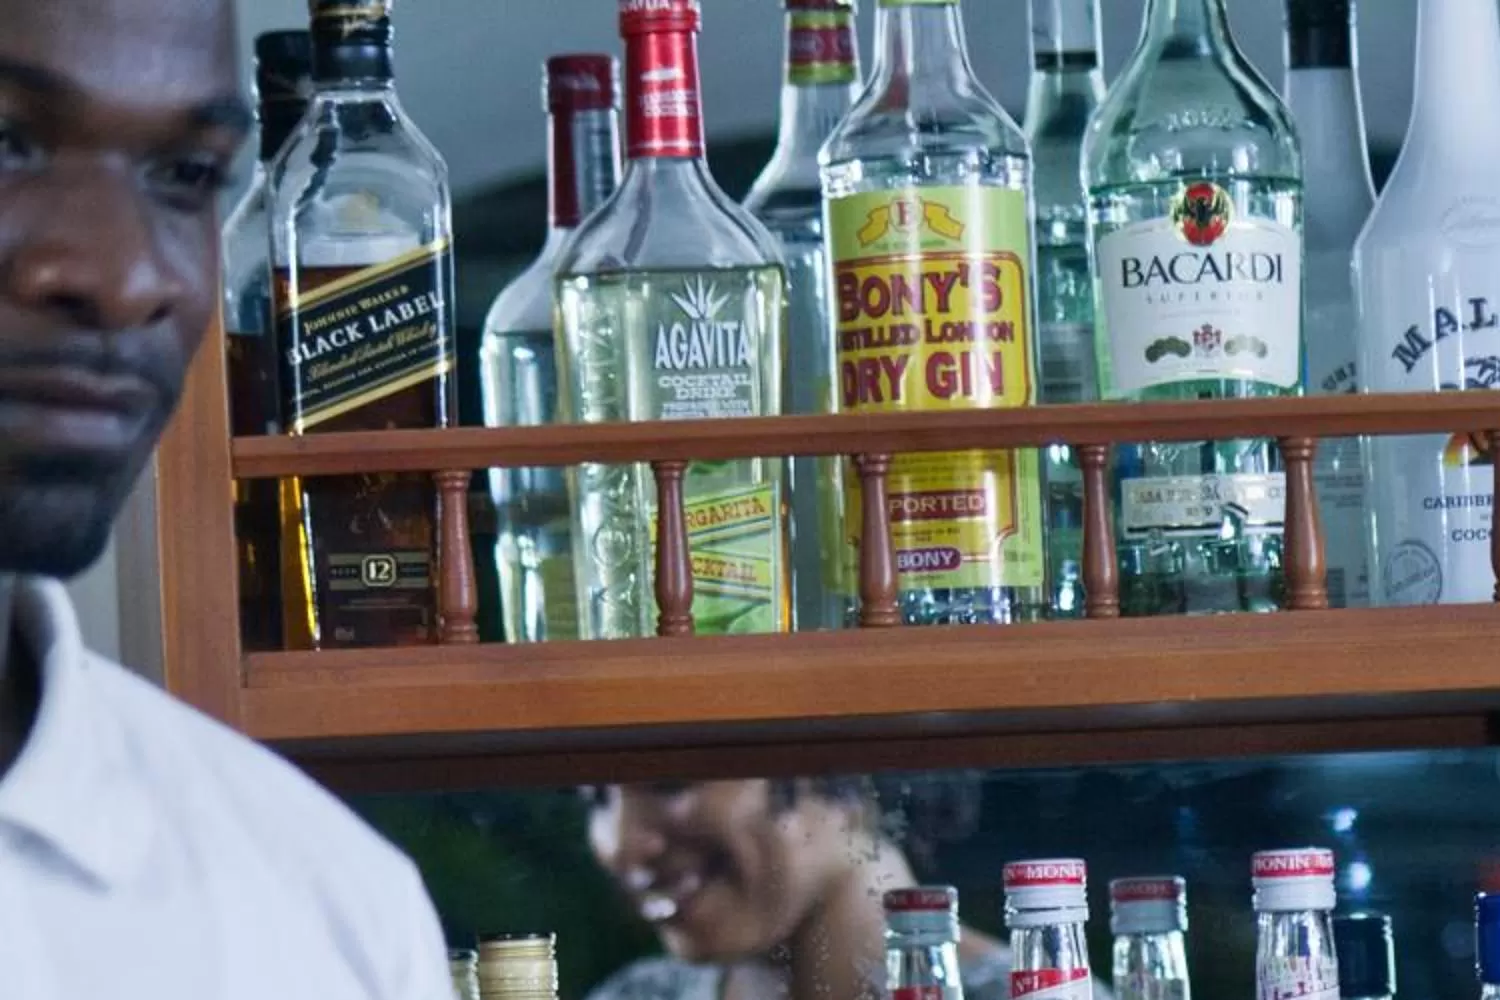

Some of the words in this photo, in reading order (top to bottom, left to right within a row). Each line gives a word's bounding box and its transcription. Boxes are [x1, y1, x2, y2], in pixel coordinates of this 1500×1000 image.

[837, 261, 1003, 323] BONY'S
[1121, 252, 1283, 289] BACARDI
[287, 321, 364, 366] BLACK
[368, 290, 446, 333] LABEL
[655, 320, 754, 370] AGAVITA
[842, 355, 908, 408] DRY
[925, 351, 1004, 400] GIN
[888, 493, 985, 514] PORTED
[369, 561, 390, 581] 12
